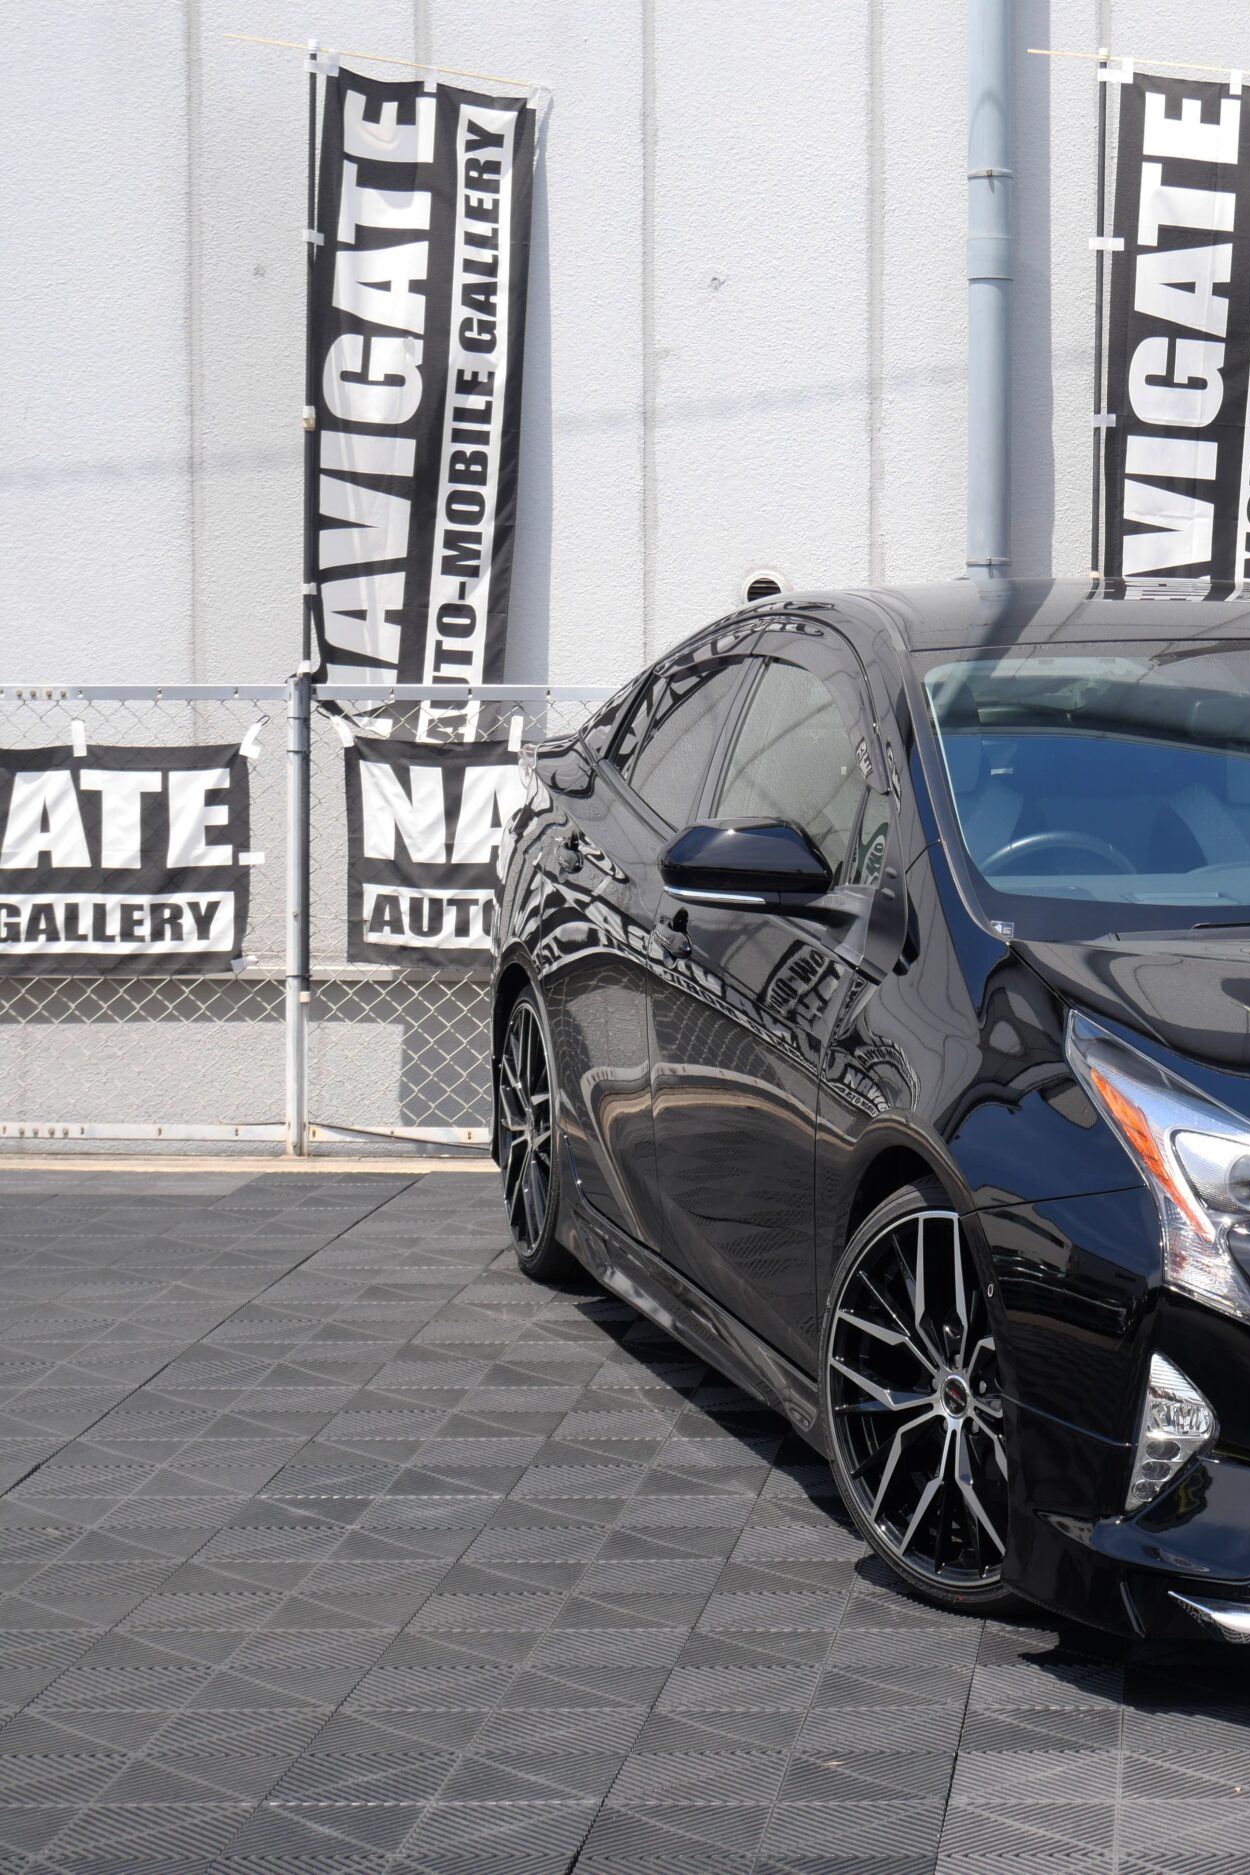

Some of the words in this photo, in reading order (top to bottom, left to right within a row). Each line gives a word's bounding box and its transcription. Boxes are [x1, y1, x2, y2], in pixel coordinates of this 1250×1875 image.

[460, 118, 505, 353] GALLERY
[1123, 92, 1241, 579] VIGATE
[0, 901, 221, 943] GALLERY
